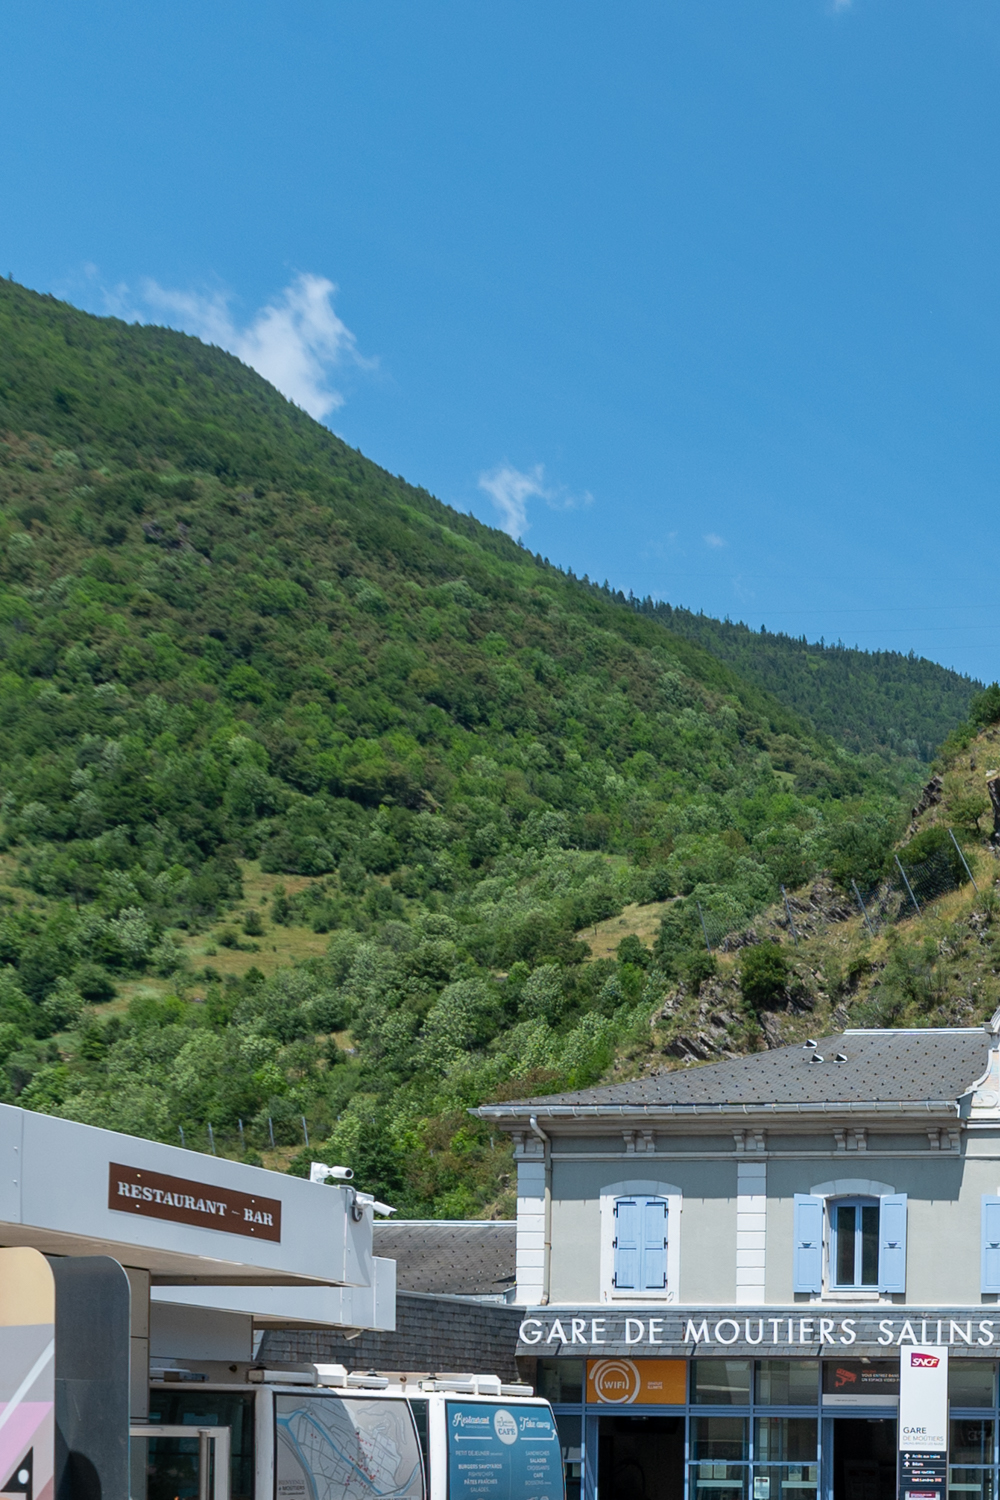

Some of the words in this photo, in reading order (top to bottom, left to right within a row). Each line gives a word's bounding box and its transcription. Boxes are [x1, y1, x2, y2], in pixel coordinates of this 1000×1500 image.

[118, 1181, 228, 1216] RESTAURANT
[243, 1208, 274, 1226] BAR
[518, 1318, 606, 1345] GARE
[624, 1318, 664, 1344] DE
[684, 1318, 857, 1345] MOUTIERS
[876, 1318, 995, 1346] SALINS
[912, 1358, 938, 1366] SNCF
[604, 1381, 626, 1390] WIFI
